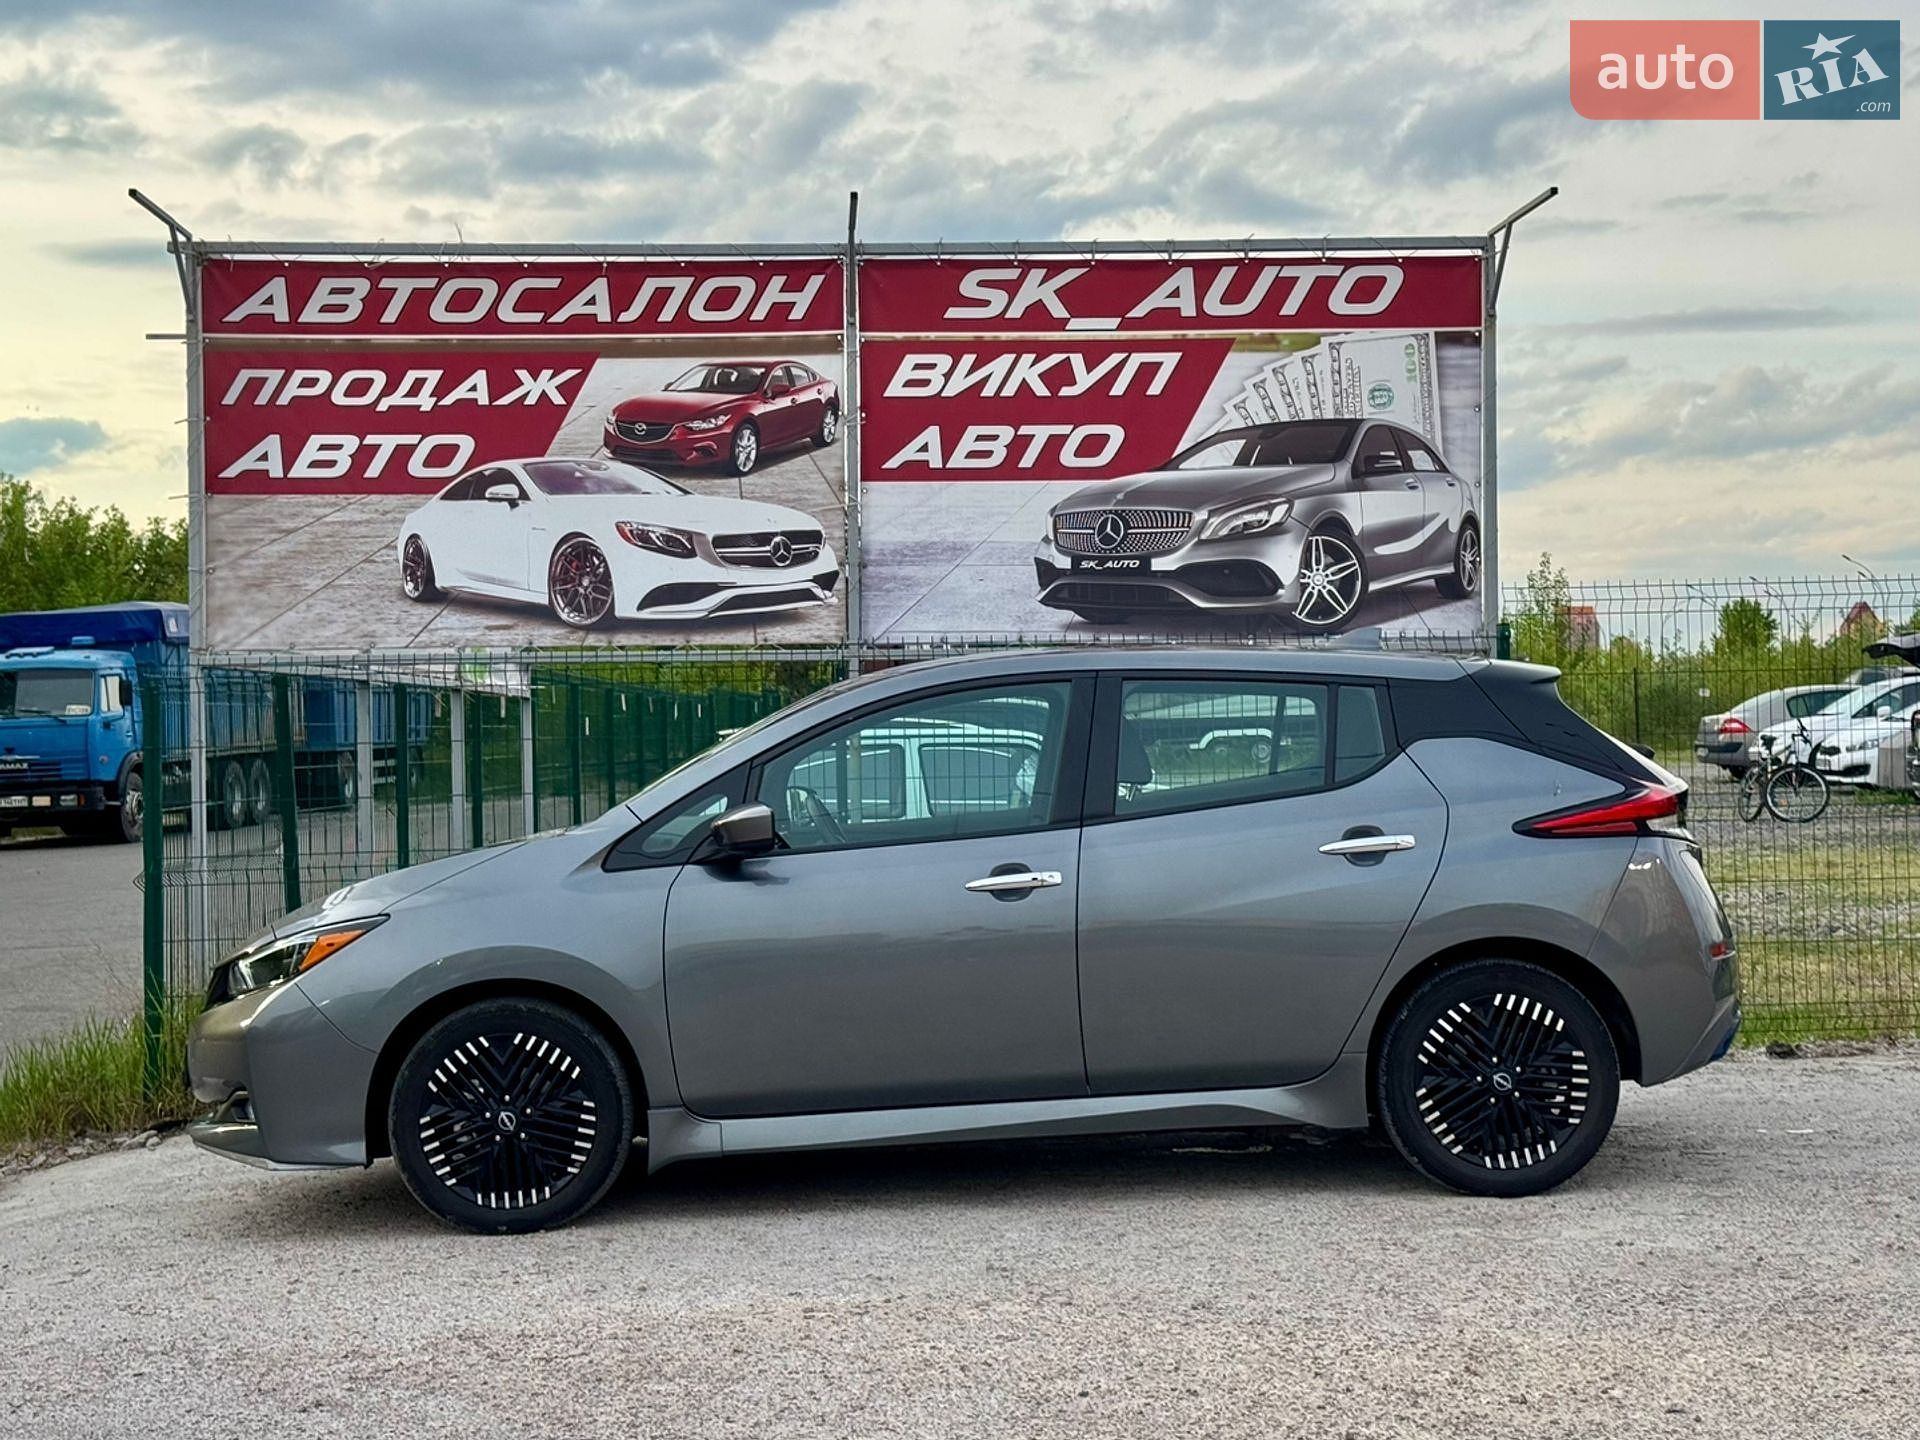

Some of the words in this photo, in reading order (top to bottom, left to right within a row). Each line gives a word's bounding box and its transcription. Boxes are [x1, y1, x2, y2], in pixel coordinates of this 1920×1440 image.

[222, 276, 826, 325] АВТОСАЛОН
[943, 265, 1404, 331] SK_AUTO
[221, 369, 583, 413] ПРОДАЖ
[884, 352, 1183, 398] ВИКУП
[218, 434, 476, 479] АВТО
[882, 424, 1126, 470] АВТО
[1080, 560, 1140, 570] SK_AUTO
